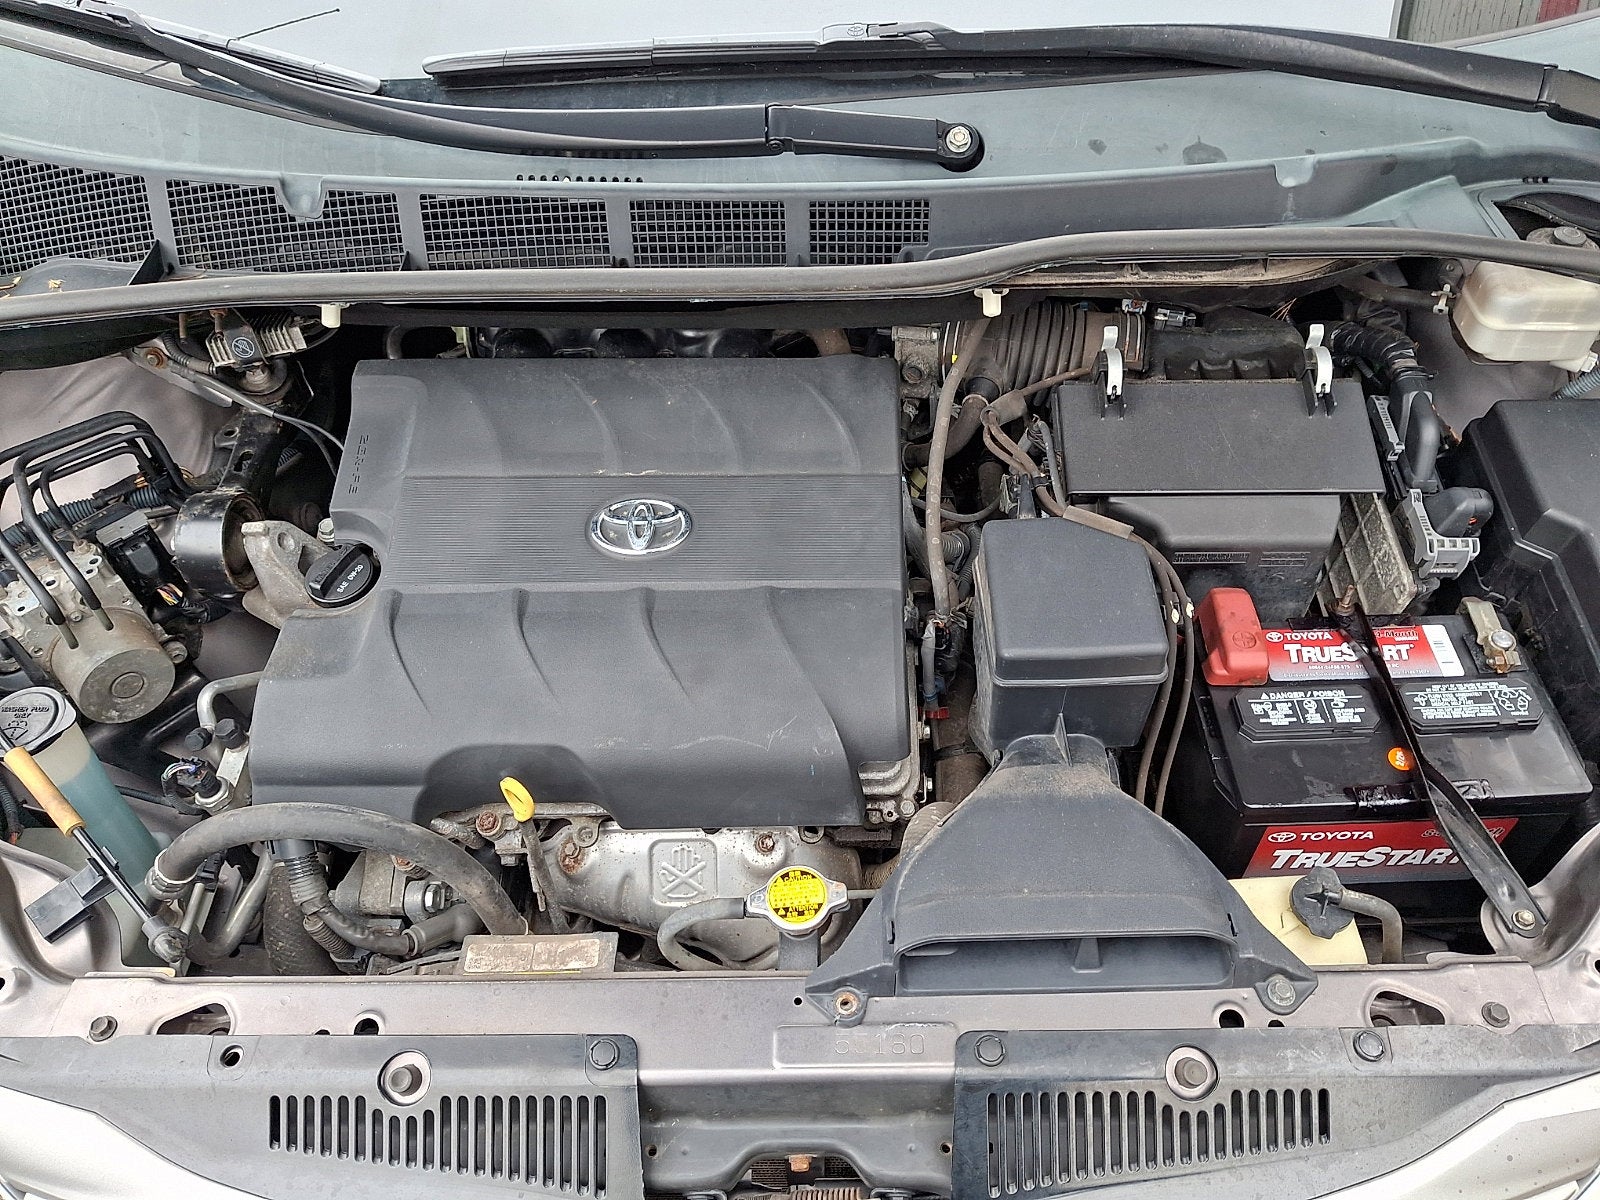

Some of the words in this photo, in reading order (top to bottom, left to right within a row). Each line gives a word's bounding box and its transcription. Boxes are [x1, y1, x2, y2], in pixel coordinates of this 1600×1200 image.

[336, 581, 349, 593] SAE
[347, 564, 364, 581] 0W-20
[1284, 631, 1333, 640] TOYOTA
[1269, 691, 1305, 700] DANGER
[1313, 690, 1346, 698] POISON
[1300, 830, 1374, 841] TOYOTA
[1271, 846, 1463, 870] TRUESTAR
[784, 873, 813, 883] CAUTION
